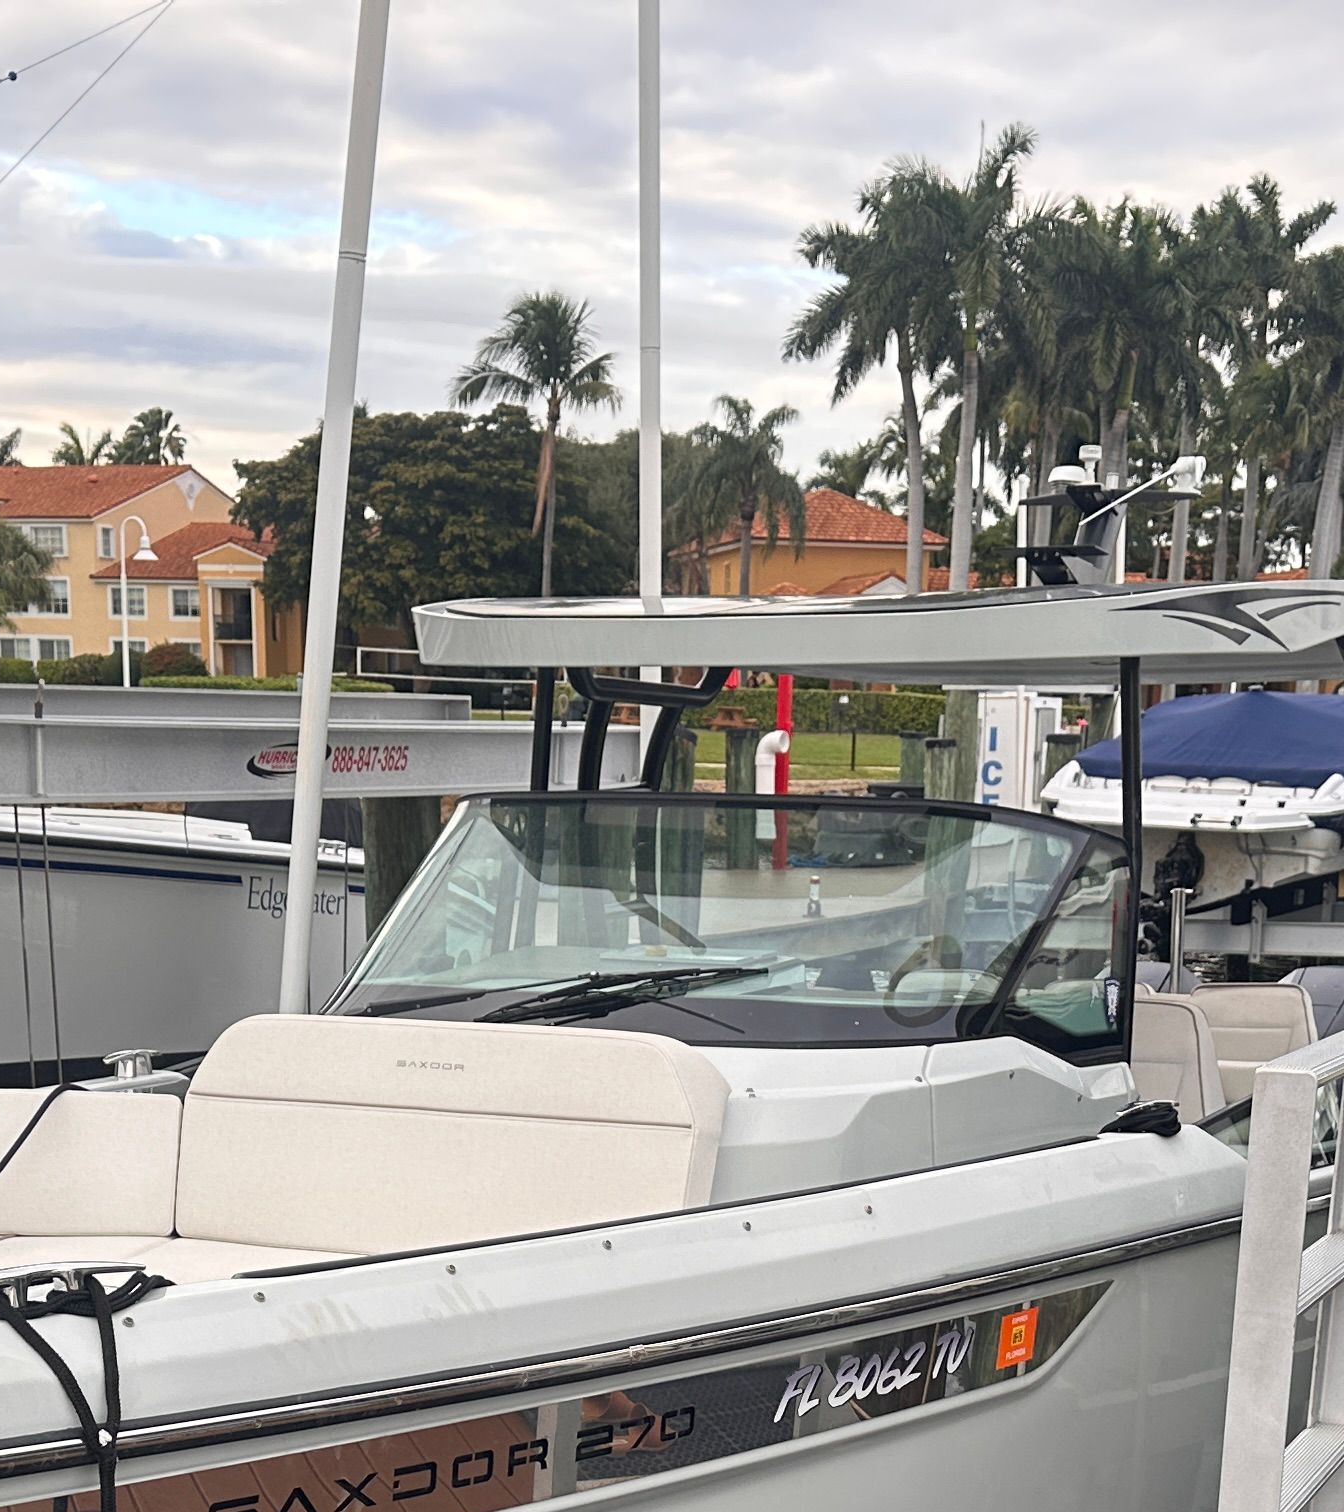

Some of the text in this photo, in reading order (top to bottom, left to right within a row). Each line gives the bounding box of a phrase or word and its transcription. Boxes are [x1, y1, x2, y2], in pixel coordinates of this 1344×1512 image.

[331, 745, 409, 773] 888-847-3625
[773, 1364, 823, 1423] FL
[828, 1341, 926, 1408] 8062
[575, 1406, 696, 1462] 270
